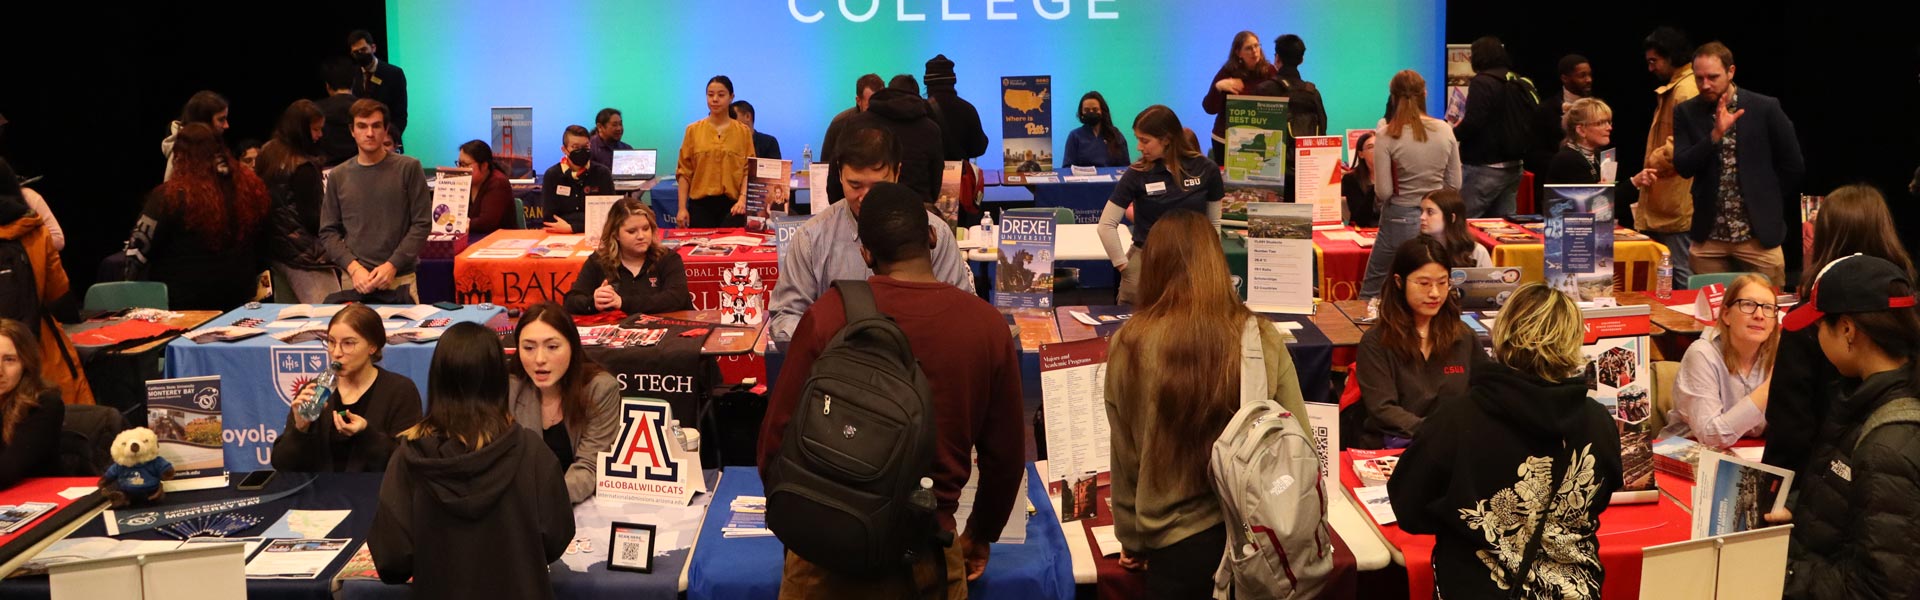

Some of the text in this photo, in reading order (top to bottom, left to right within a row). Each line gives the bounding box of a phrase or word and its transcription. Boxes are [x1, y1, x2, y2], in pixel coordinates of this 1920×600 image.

[788, 0, 1120, 23] COLLEGE
[1184, 178, 1200, 186] CBU
[778, 226, 801, 242] DR
[1002, 219, 1052, 235] DREXEL
[634, 374, 693, 392] TECH
[606, 404, 678, 482] A
[599, 480, 684, 494] #GLOBALWILDCATS
[165, 499, 261, 519] MONTEREY BAY
[223, 497, 260, 506] University
